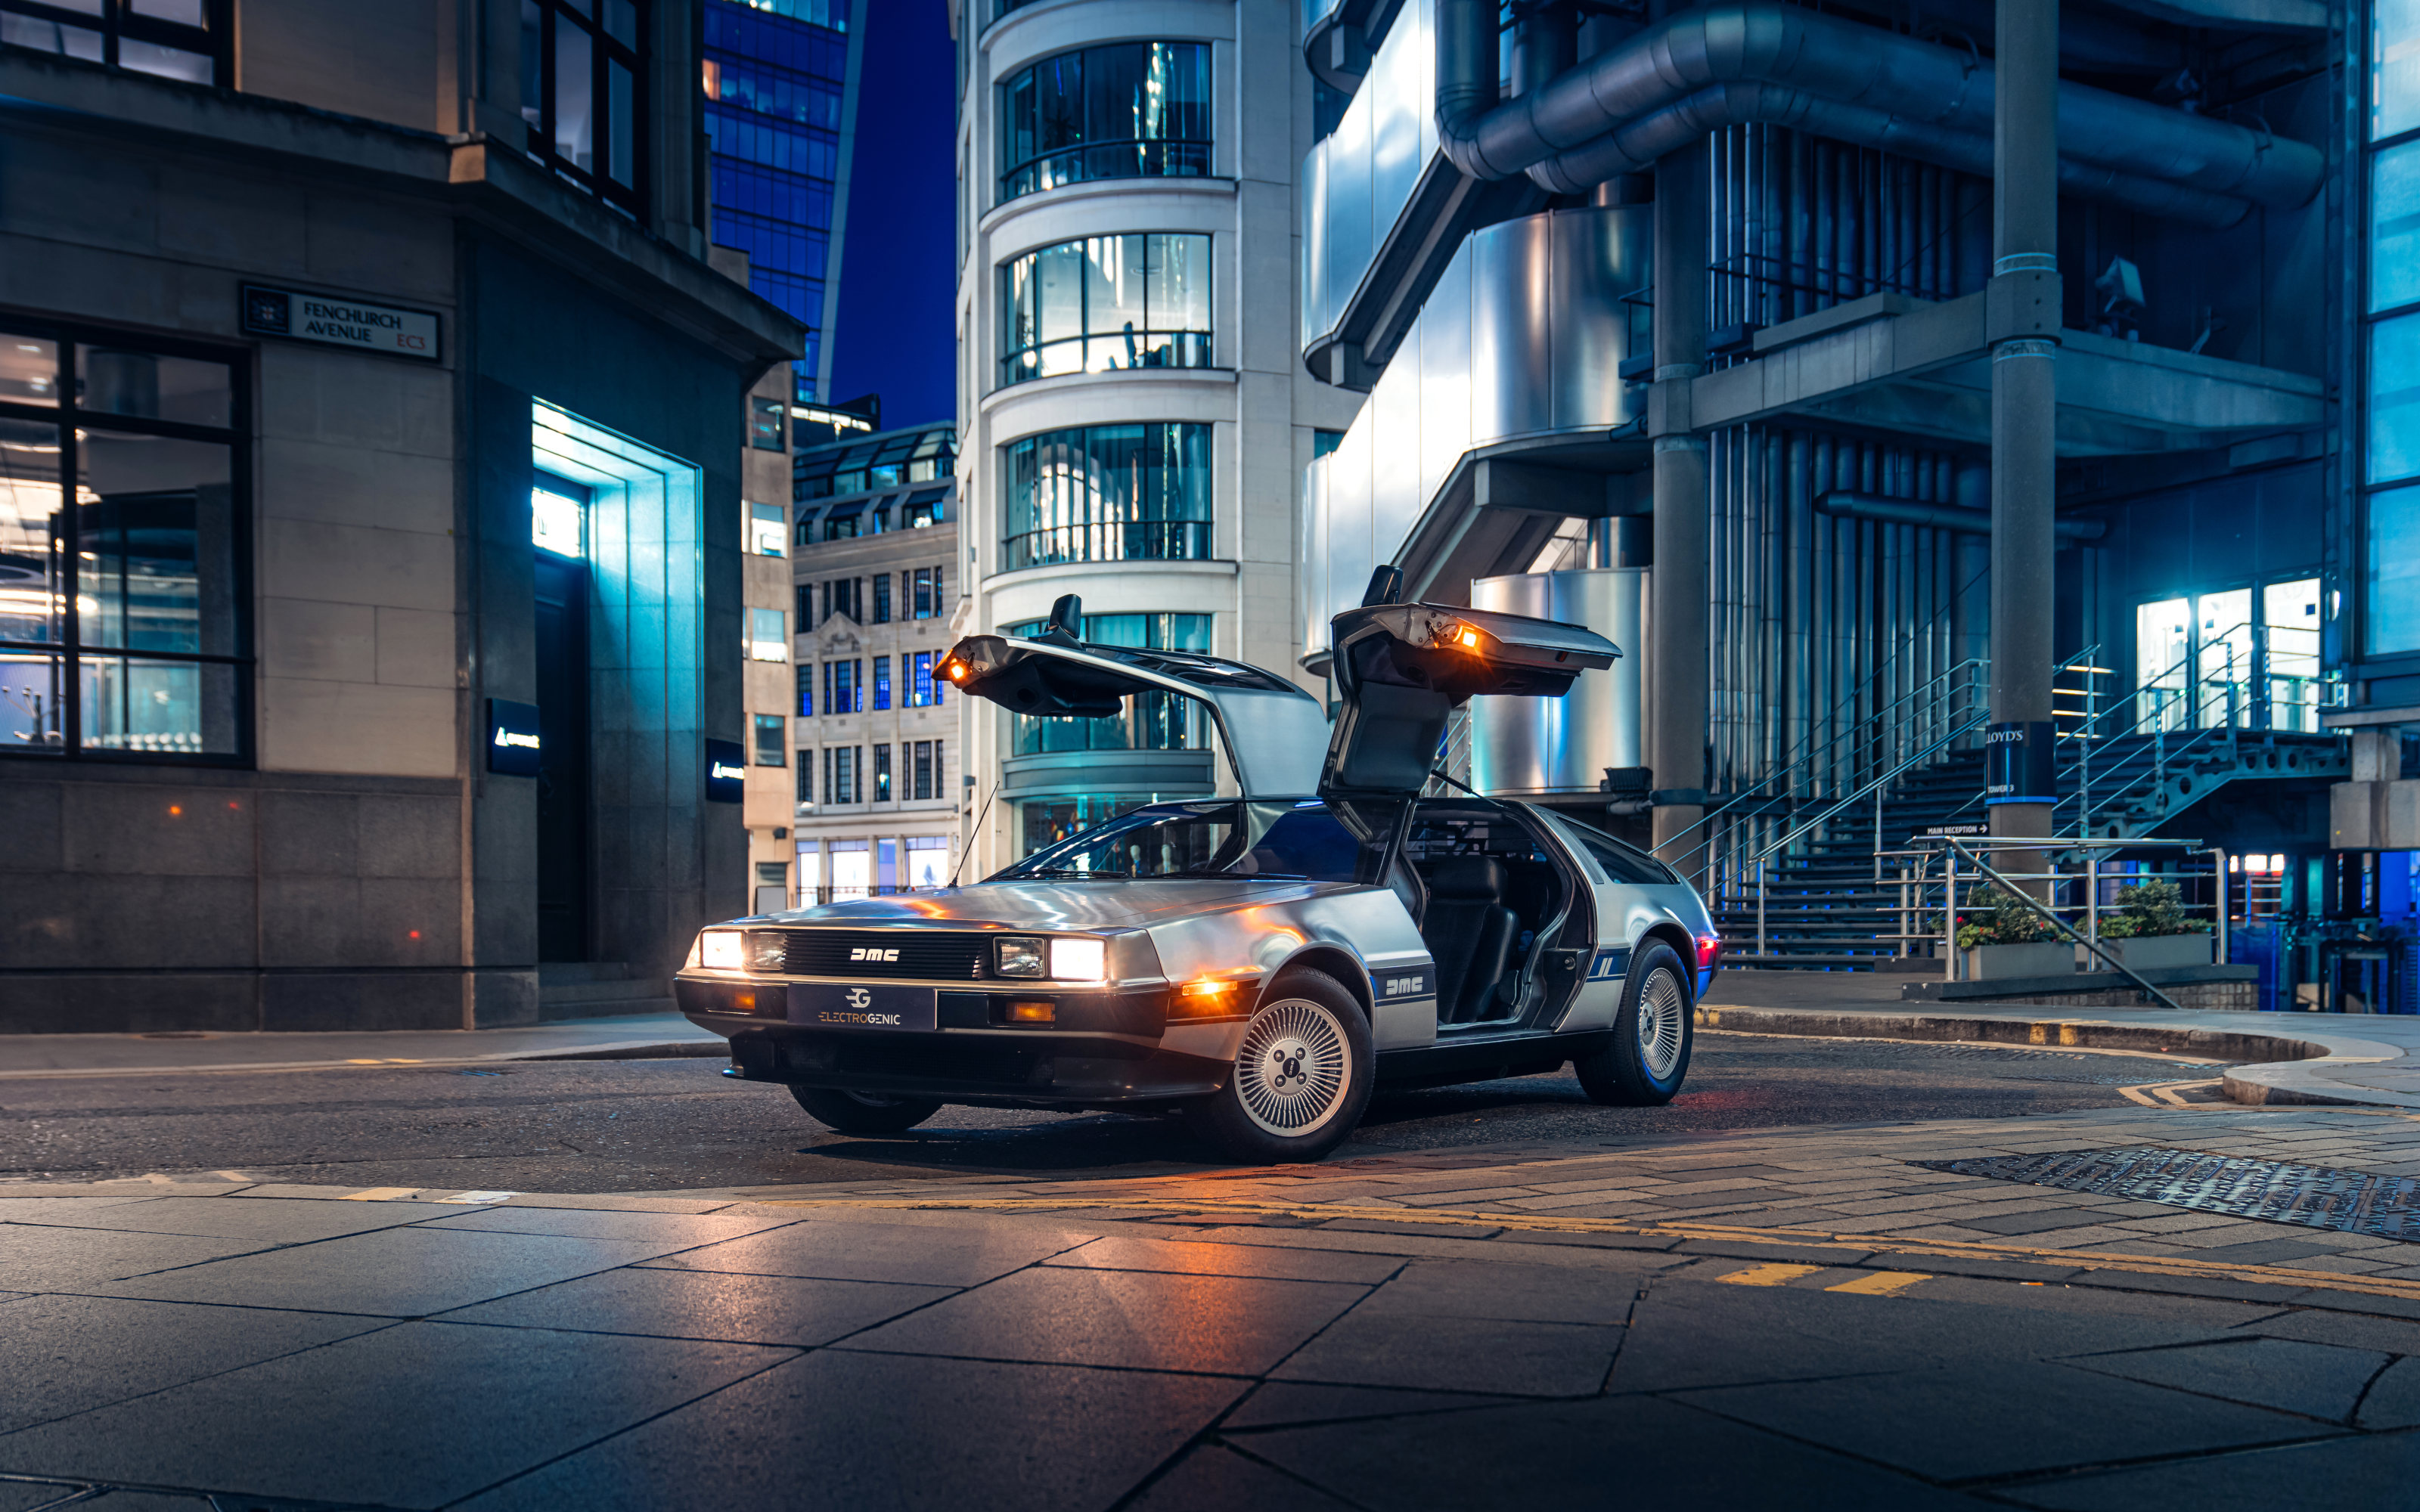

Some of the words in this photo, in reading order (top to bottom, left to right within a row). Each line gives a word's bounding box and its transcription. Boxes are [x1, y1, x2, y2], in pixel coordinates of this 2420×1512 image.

[304, 302, 402, 330] FENCHURCH
[305, 321, 372, 342] AVENUE
[396, 333, 425, 350] EC3
[2009, 784, 2015, 792] 3
[1944, 825, 1978, 834] RECEPTION
[850, 948, 900, 962] DMC
[1386, 976, 1423, 995] DMC
[818, 1012, 901, 1025] ELECTROGENIC
